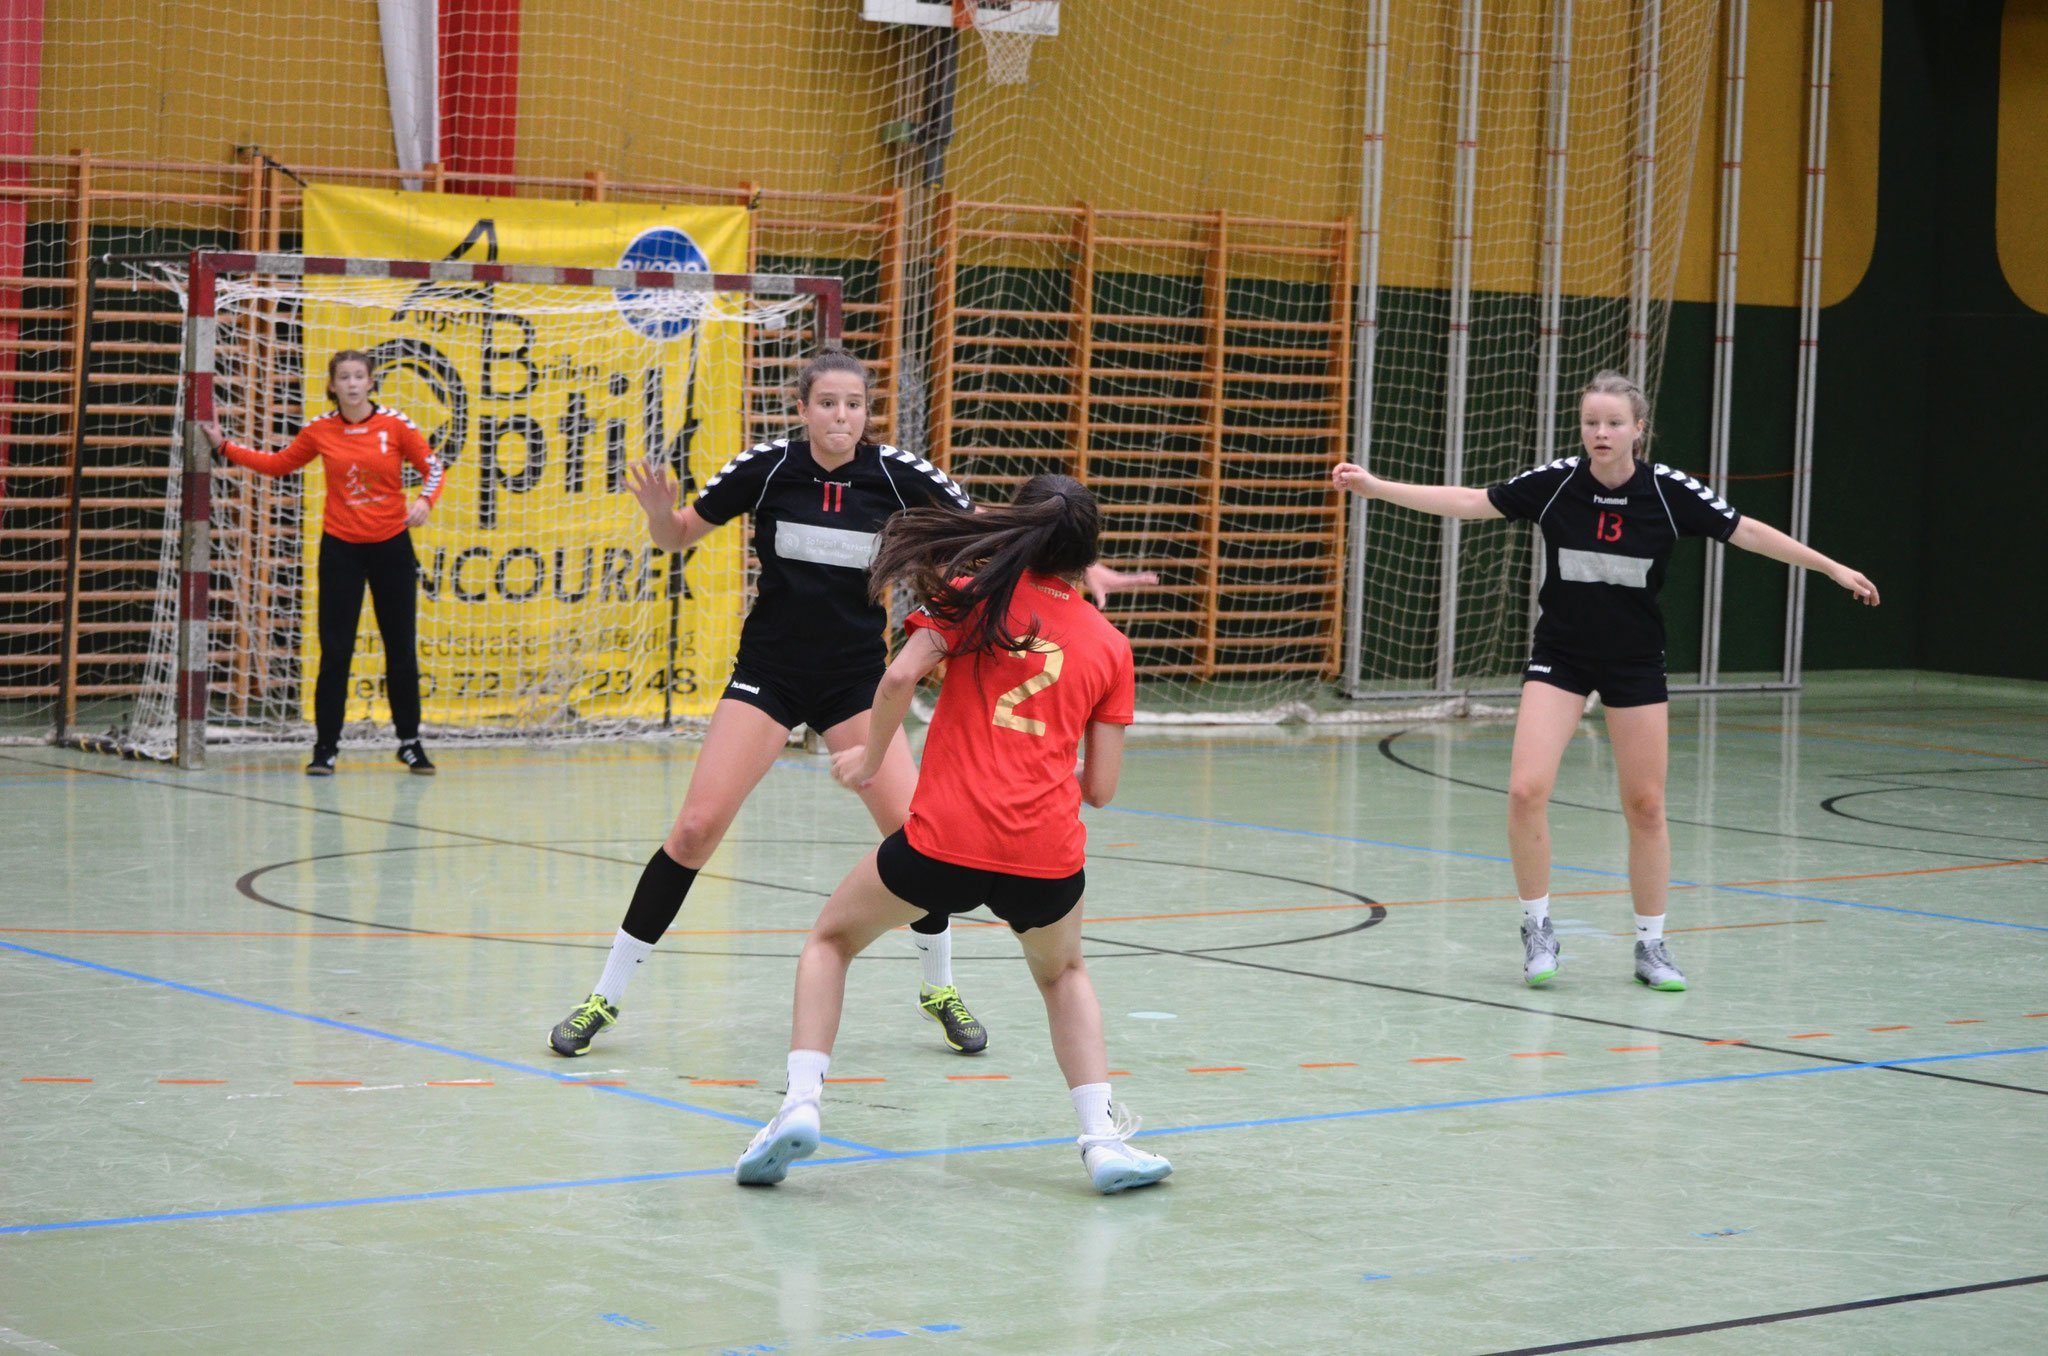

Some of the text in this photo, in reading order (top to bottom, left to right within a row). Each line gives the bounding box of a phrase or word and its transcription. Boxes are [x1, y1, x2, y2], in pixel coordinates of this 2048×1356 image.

[378, 431, 388, 454] 1
[822, 482, 843, 512] 11
[1593, 494, 1628, 505] hummel
[1597, 511, 1624, 542] 13
[416, 546, 697, 602] NCOUREK
[992, 635, 1064, 736] 2
